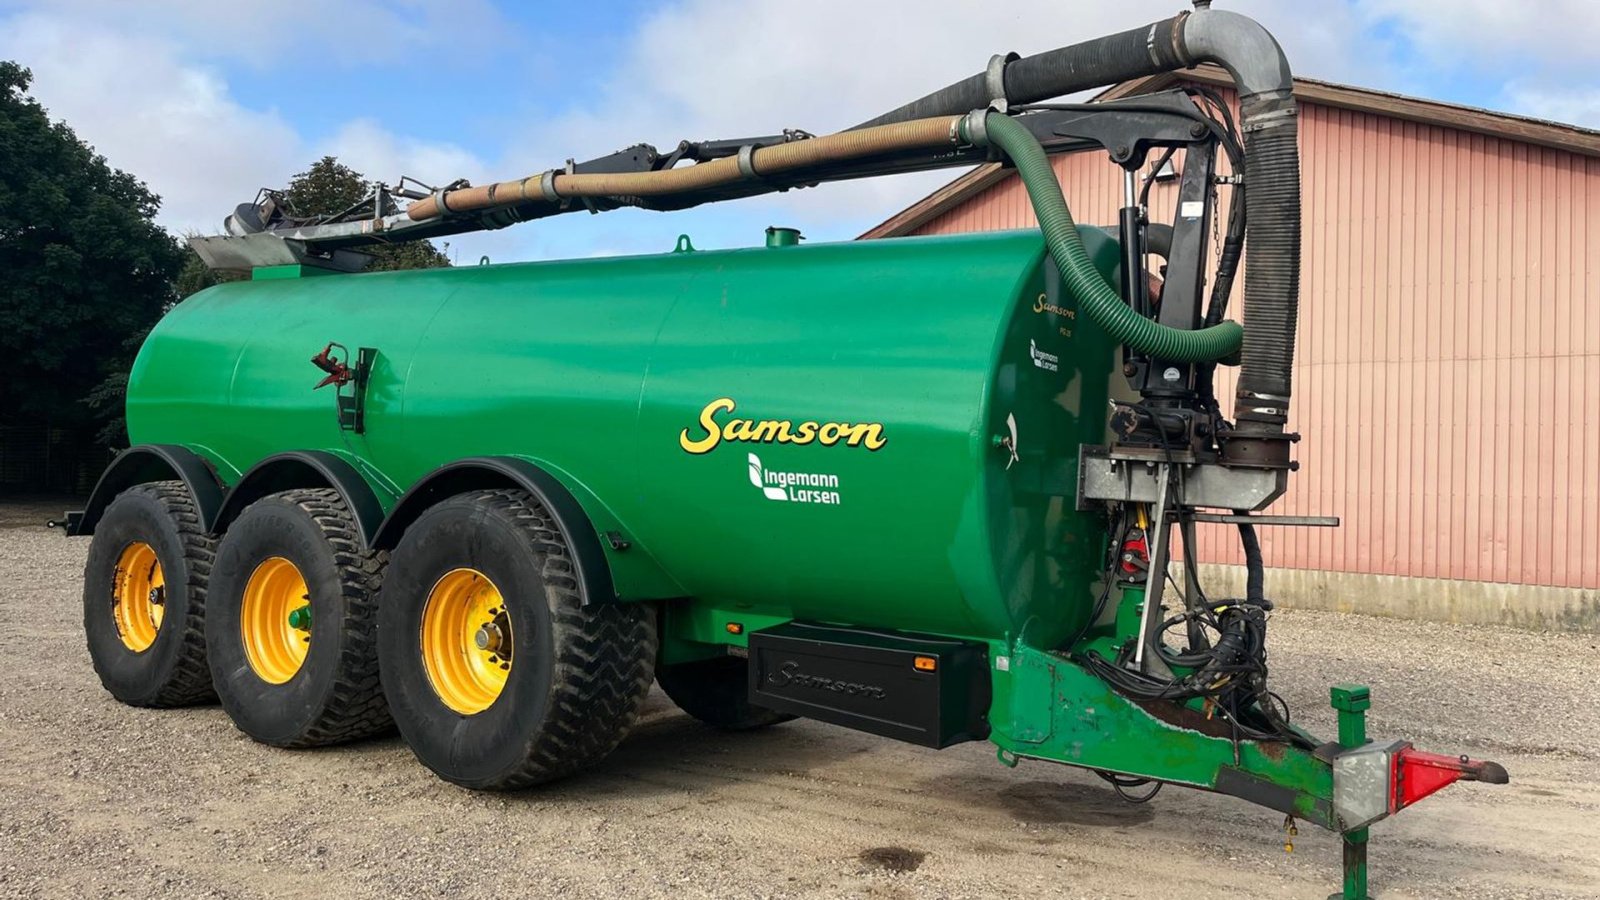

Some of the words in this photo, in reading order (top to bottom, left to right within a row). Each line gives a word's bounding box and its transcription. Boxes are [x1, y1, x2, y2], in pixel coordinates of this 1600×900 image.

[1033, 293, 1075, 320] Samson
[680, 397, 887, 455] Samson
[764, 469, 839, 488] Ingemann
[790, 487, 841, 505] Larsen
[768, 661, 886, 699] Samson
